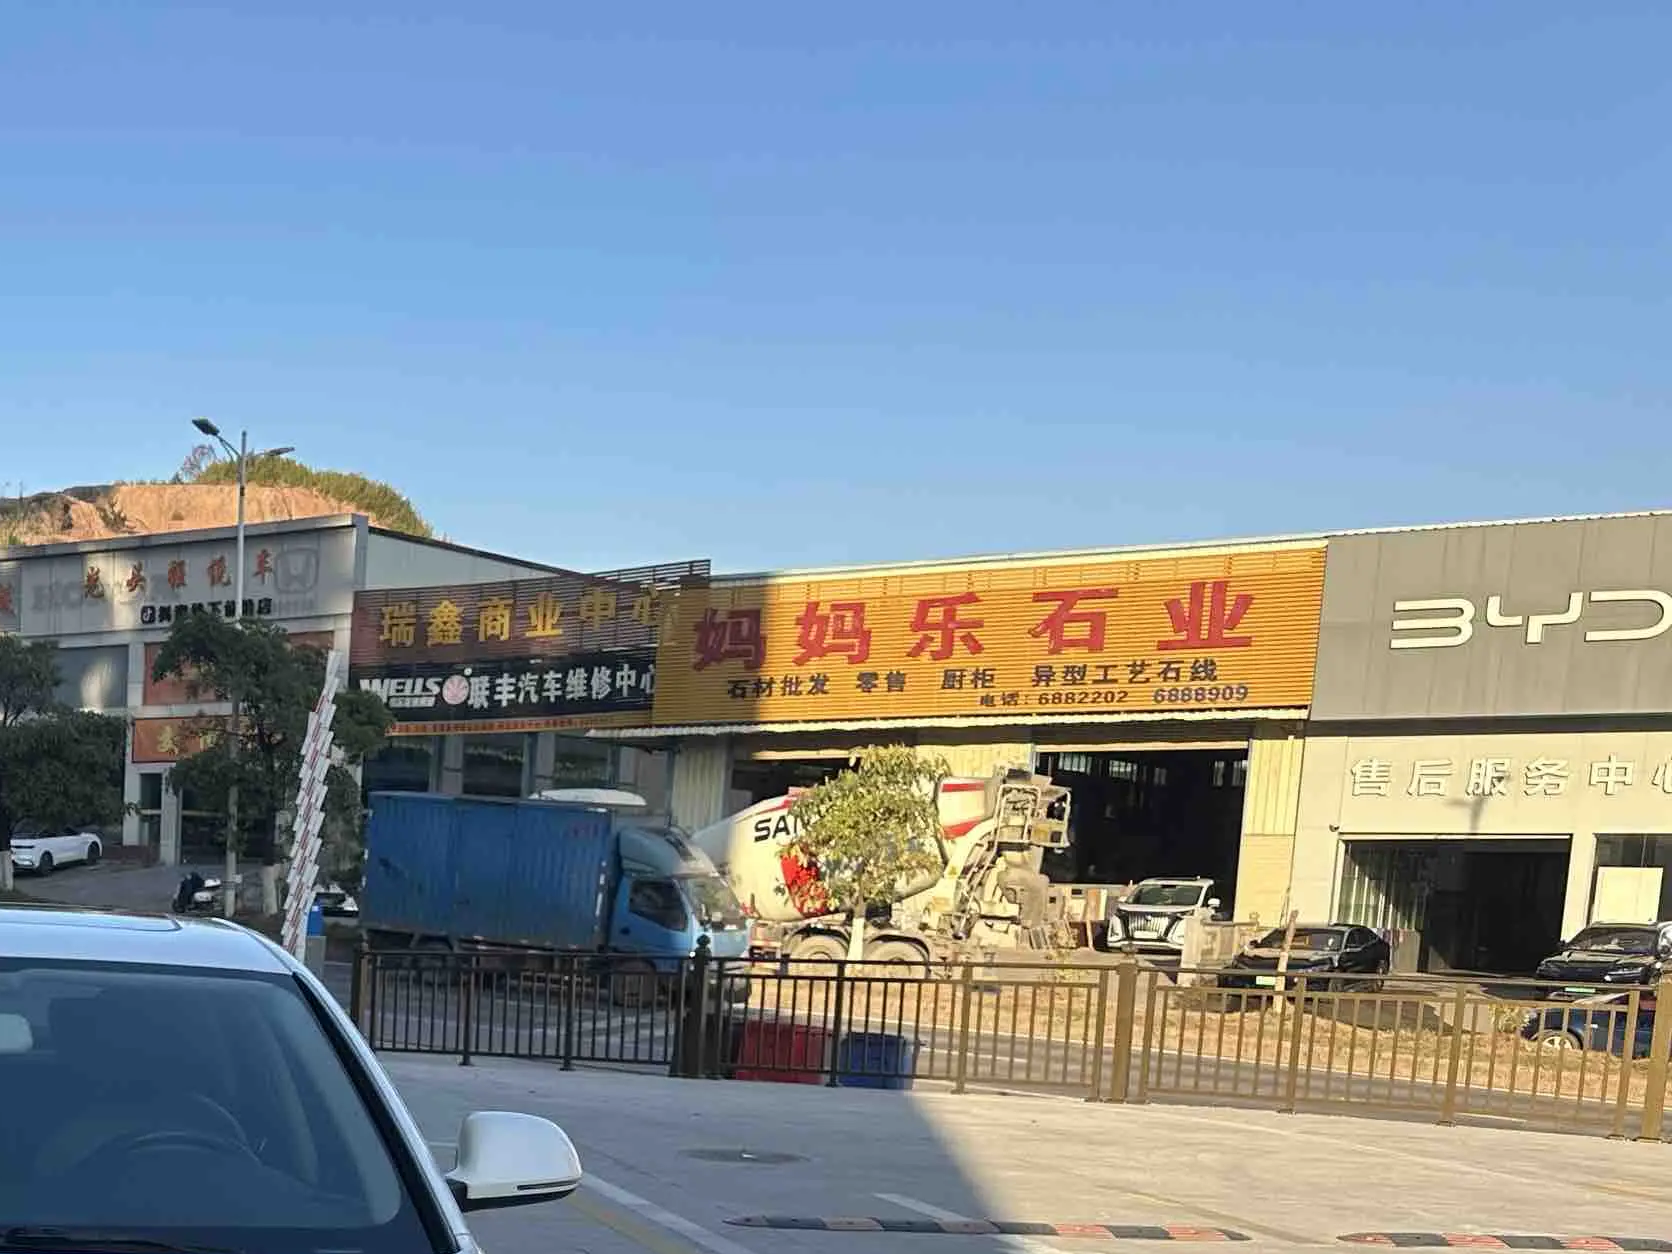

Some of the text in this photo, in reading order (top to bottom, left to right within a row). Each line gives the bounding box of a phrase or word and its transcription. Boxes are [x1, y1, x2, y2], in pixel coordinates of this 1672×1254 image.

[692, 579, 1256, 672] 妈妈乐石业
[1389, 590, 1672, 650] BYD
[728, 658, 1219, 698] 石材批发 零售 厨柜 异型工艺石线
[1152, 685, 1249, 704] 6888909
